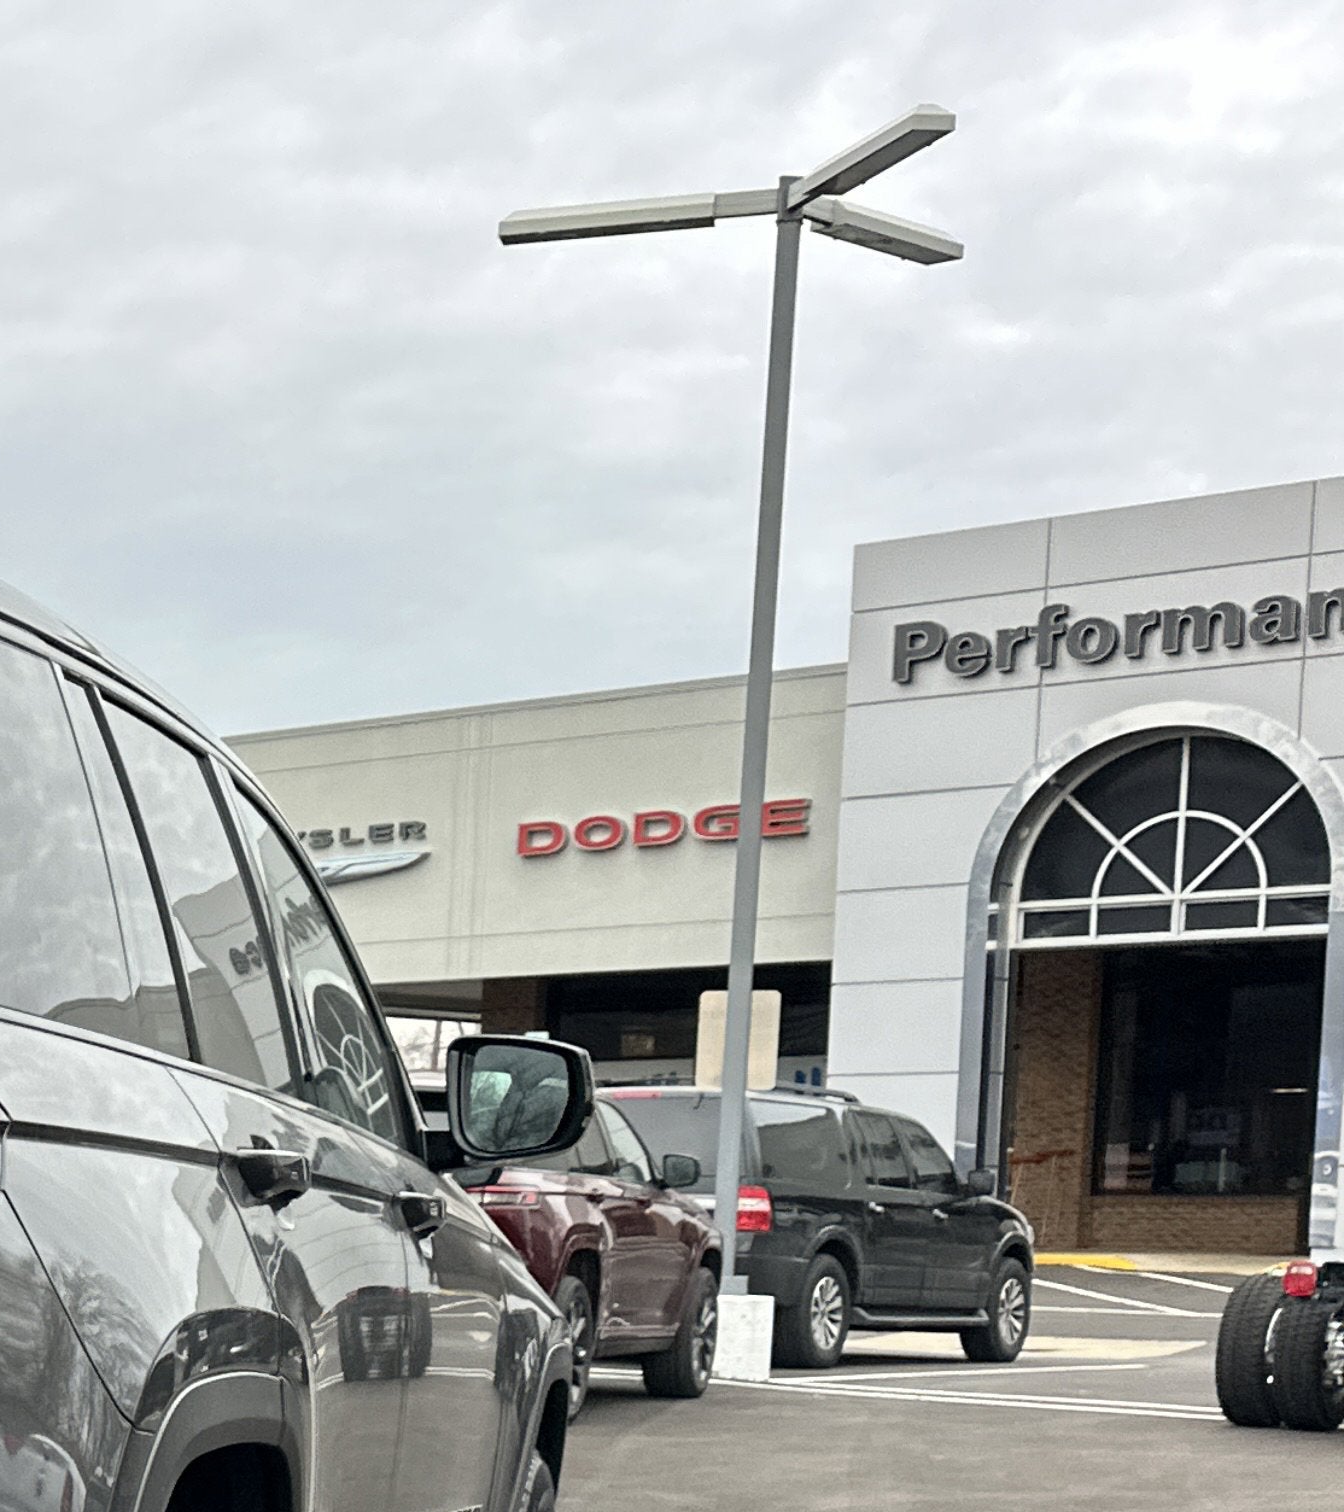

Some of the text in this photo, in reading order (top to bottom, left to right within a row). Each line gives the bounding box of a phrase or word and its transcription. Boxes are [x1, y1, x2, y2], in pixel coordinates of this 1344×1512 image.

[892, 588, 1344, 685] Performan
[297, 821, 427, 849] SLER
[517, 798, 812, 859] DODGE
